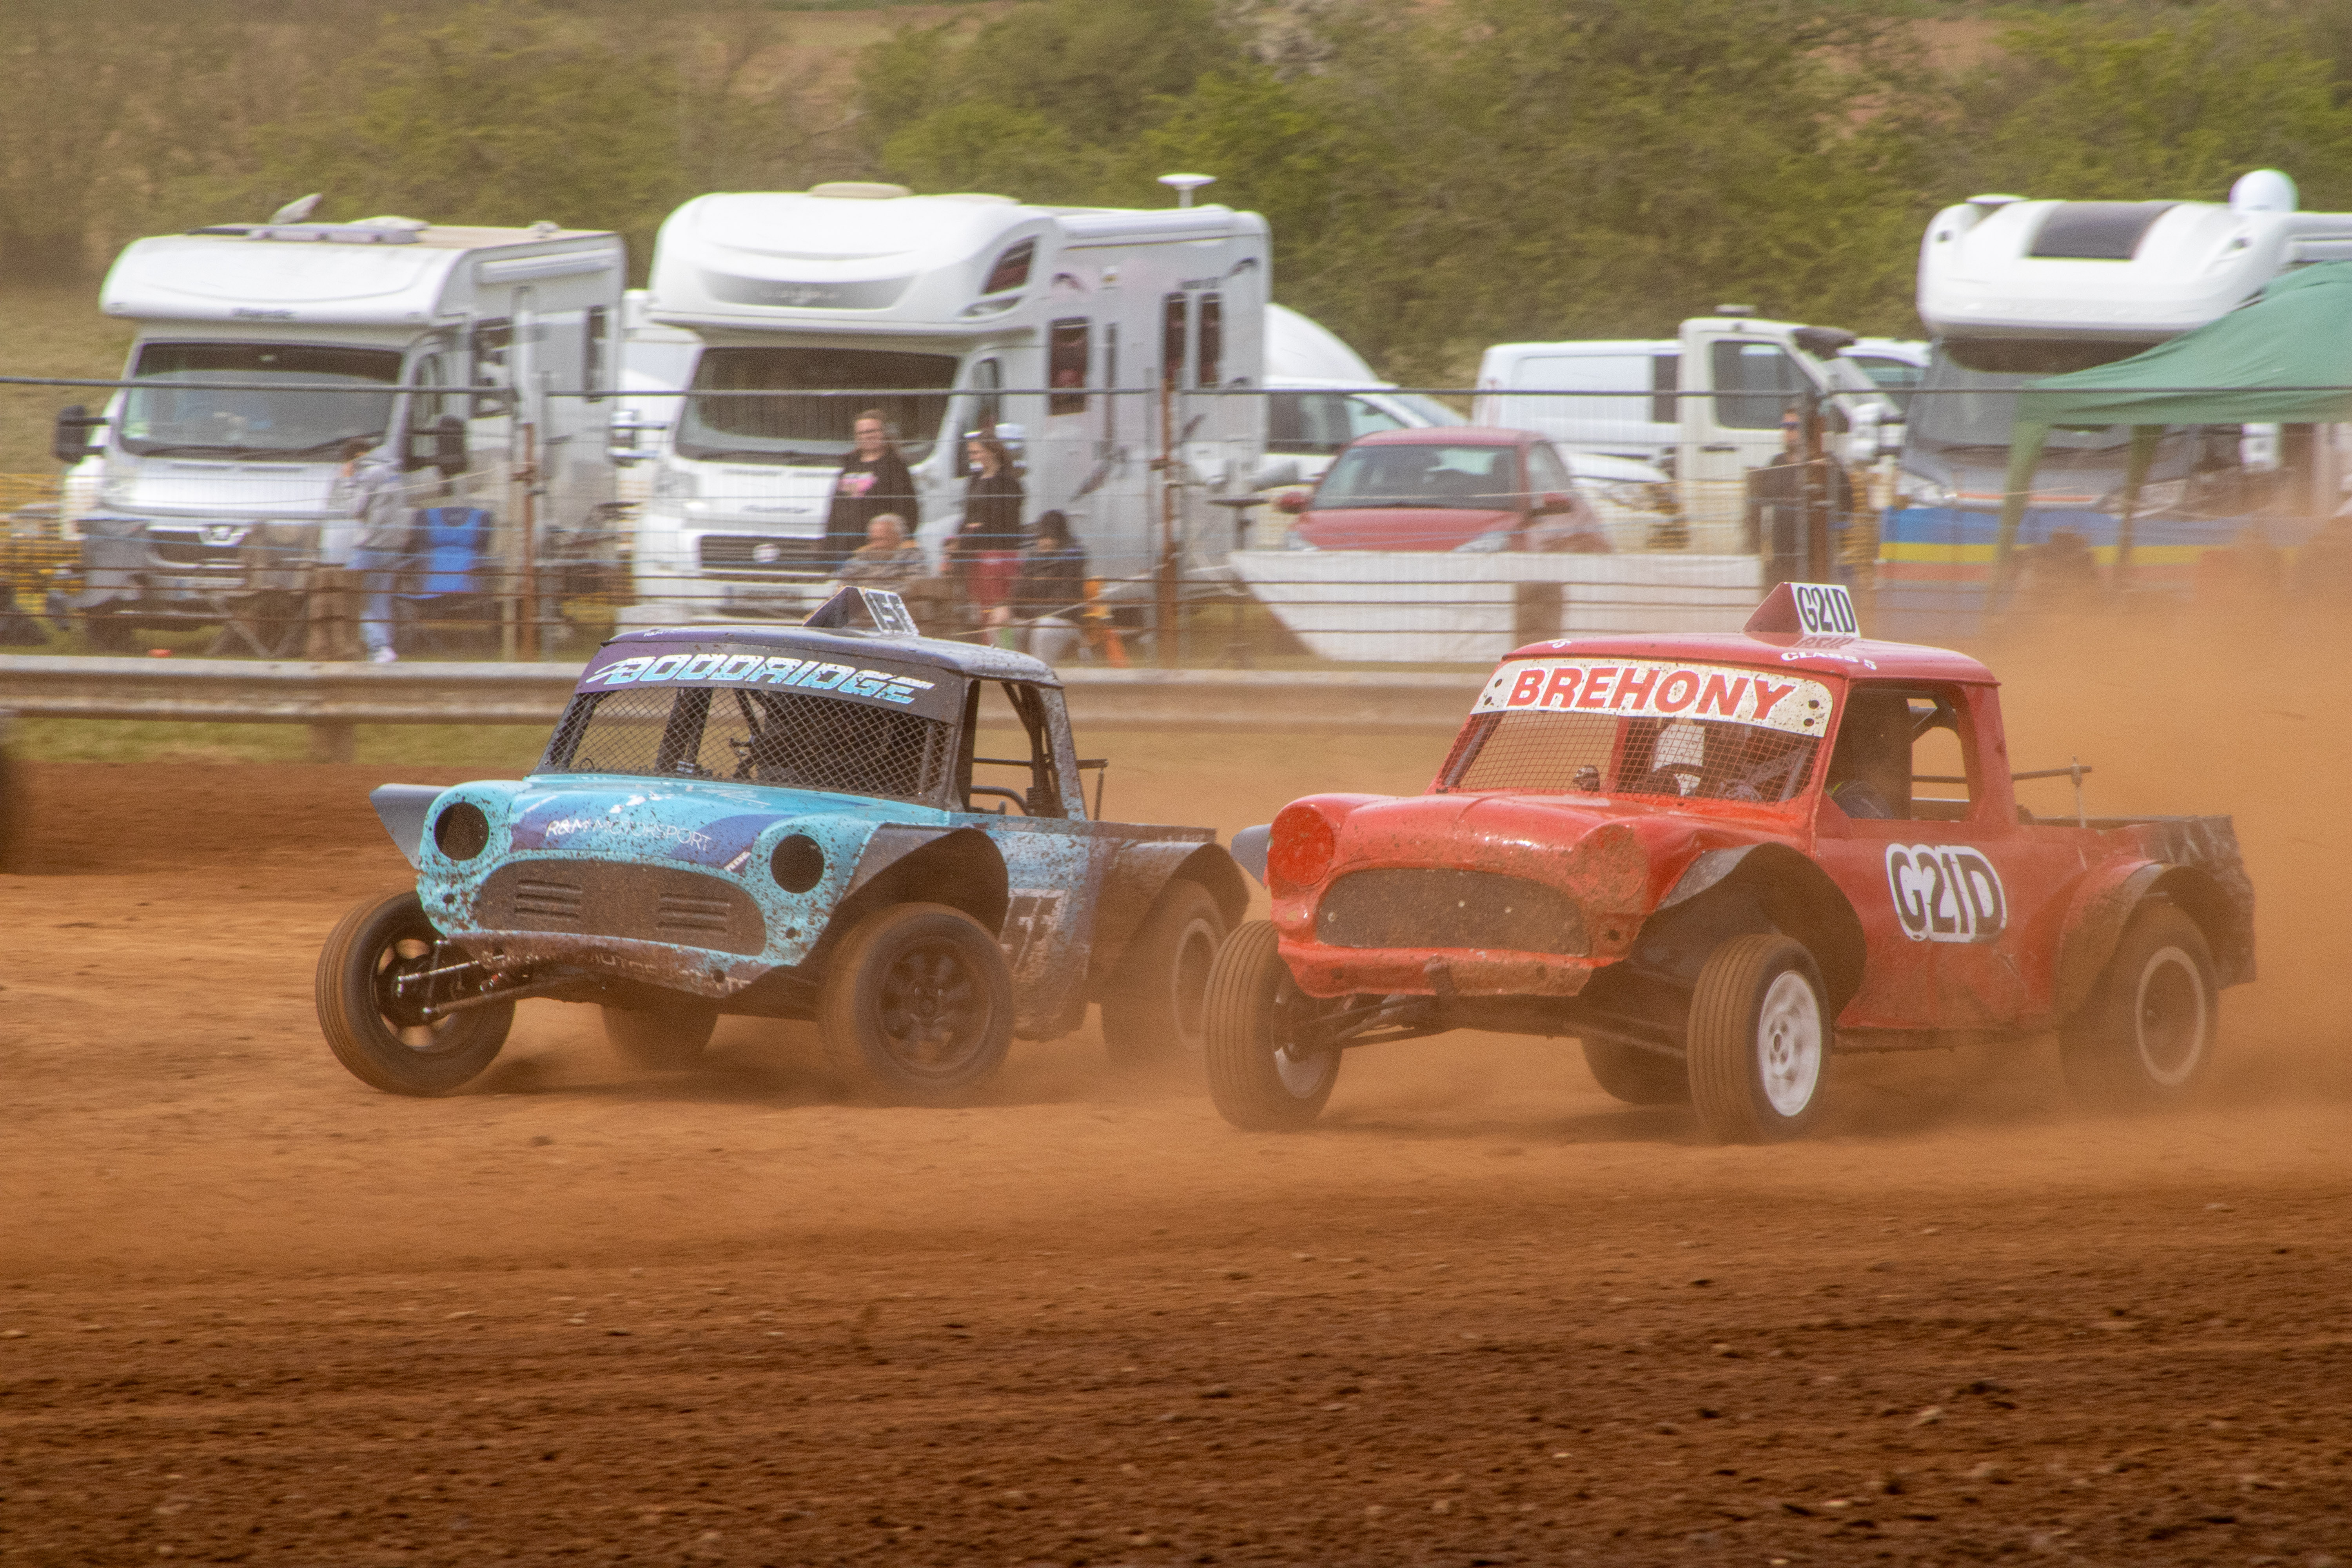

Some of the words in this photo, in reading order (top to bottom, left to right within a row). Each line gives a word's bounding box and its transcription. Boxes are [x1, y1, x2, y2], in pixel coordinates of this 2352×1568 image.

[1797, 586, 1856, 633] G21D
[1780, 652, 1859, 663] CLASS
[1863, 658, 1877, 670] 5
[1506, 667, 1796, 720] BREHONY
[592, 819, 712, 851] MOTORSPORT
[1889, 849, 2005, 937] G21D
